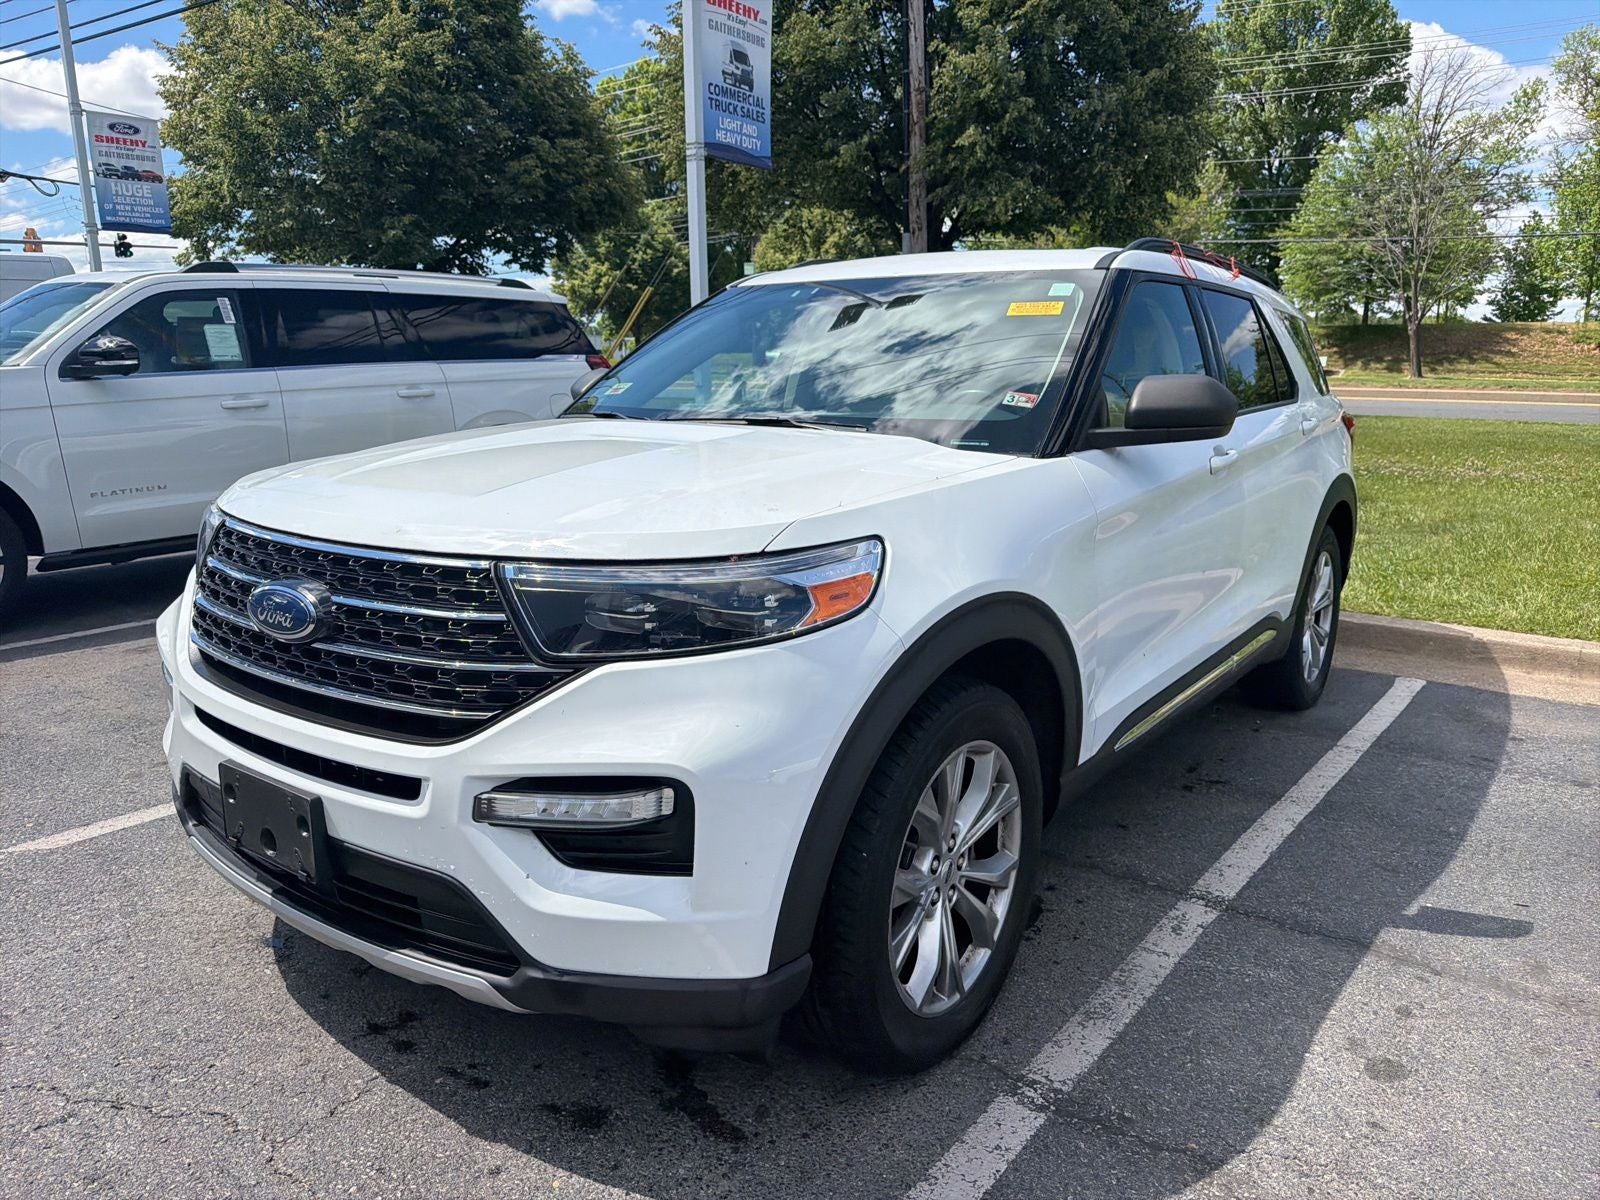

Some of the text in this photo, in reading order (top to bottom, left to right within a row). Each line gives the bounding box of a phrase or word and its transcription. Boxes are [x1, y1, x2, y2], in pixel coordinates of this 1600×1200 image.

[708, 19, 766, 48] GAITHERSBURG
[708, 82, 766, 110] COMMERCIAL
[708, 97, 766, 124] TRUCK SALES
[719, 117, 758, 137] LIGHT AND
[94, 134, 148, 148] SHEEHY
[715, 129, 761, 151] HEAVY DUTY
[98, 150, 157, 163] GAITHERSBURG
[111, 182, 152, 197] HUGE
[113, 196, 154, 206] SELECTION
[132, 205, 164, 214] VEHICLES
[1007, 395, 1015, 403] 3
[90, 484, 168, 498] PLATINUM
[257, 594, 297, 628] Ford
